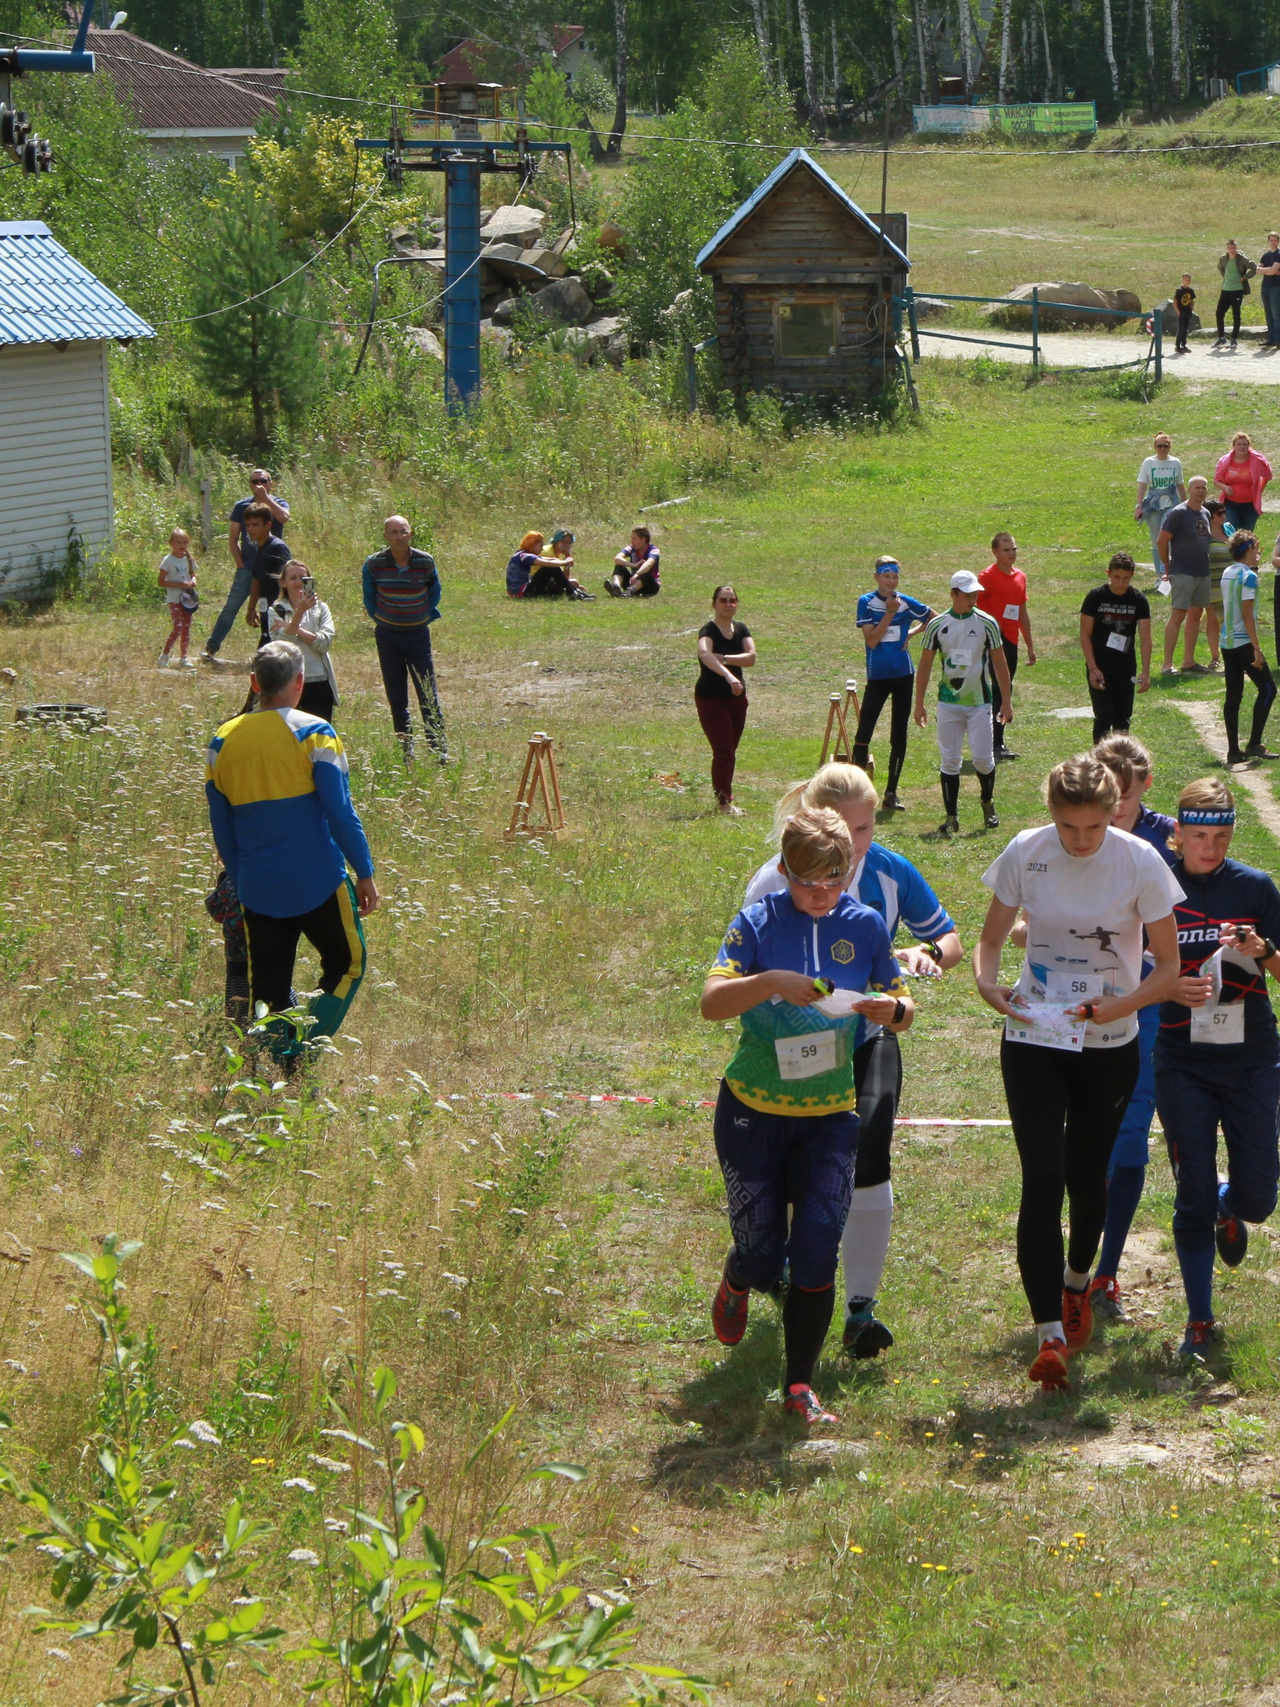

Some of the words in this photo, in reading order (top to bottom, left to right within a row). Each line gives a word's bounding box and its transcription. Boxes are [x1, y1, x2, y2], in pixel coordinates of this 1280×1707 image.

[1004, 106, 1039, 119] МИНСПОРТ
[1182, 811, 1235, 824] TRIMTE
[1027, 862, 1048, 873] 2021
[1177, 927, 1220, 944] ona
[1071, 981, 1087, 993] 58
[1213, 1013, 1229, 1025] 57
[801, 1045, 817, 1058] 59
